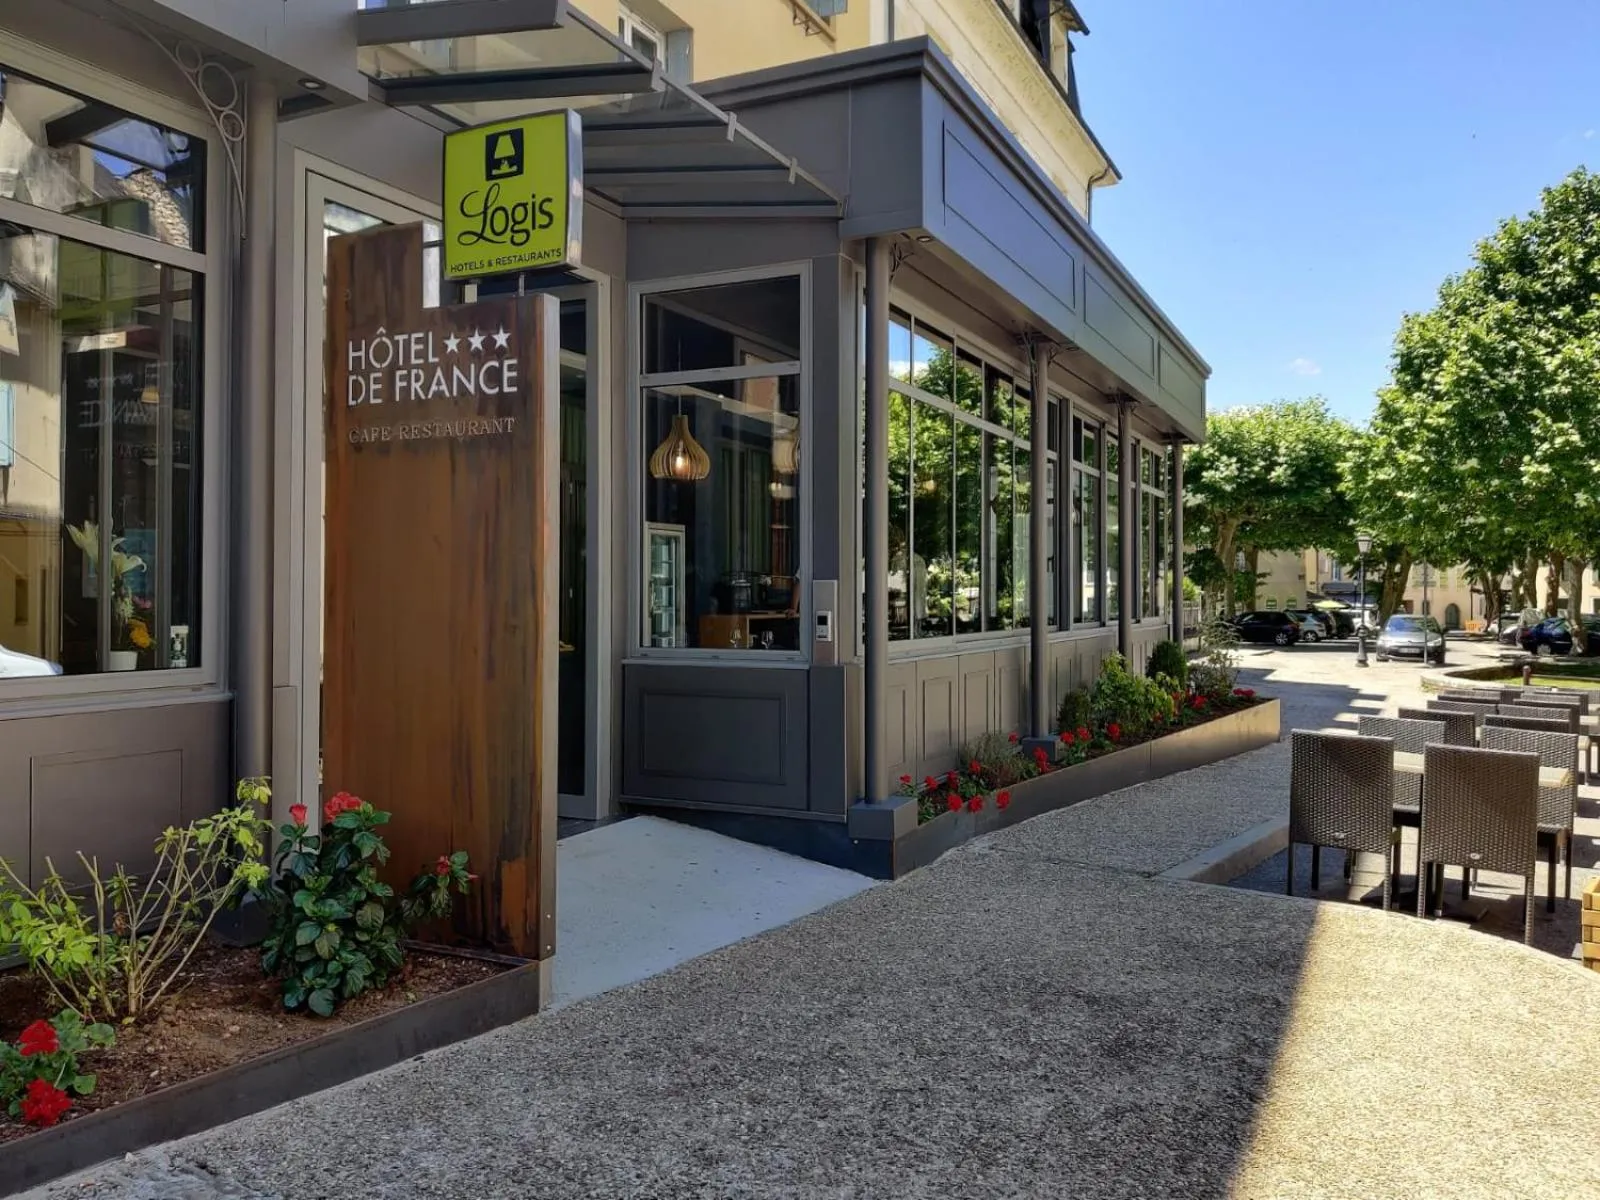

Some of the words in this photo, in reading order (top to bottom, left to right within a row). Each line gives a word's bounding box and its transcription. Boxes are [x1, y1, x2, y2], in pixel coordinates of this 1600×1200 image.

[457, 183, 554, 247] Logis
[450, 261, 485, 273] HOTELS
[495, 248, 562, 266] RESTAURANTS
[348, 327, 440, 371] HÔTEL
[348, 373, 383, 406] DE
[395, 358, 518, 402] FRANCE
[399, 417, 516, 440] RESTAURANT
